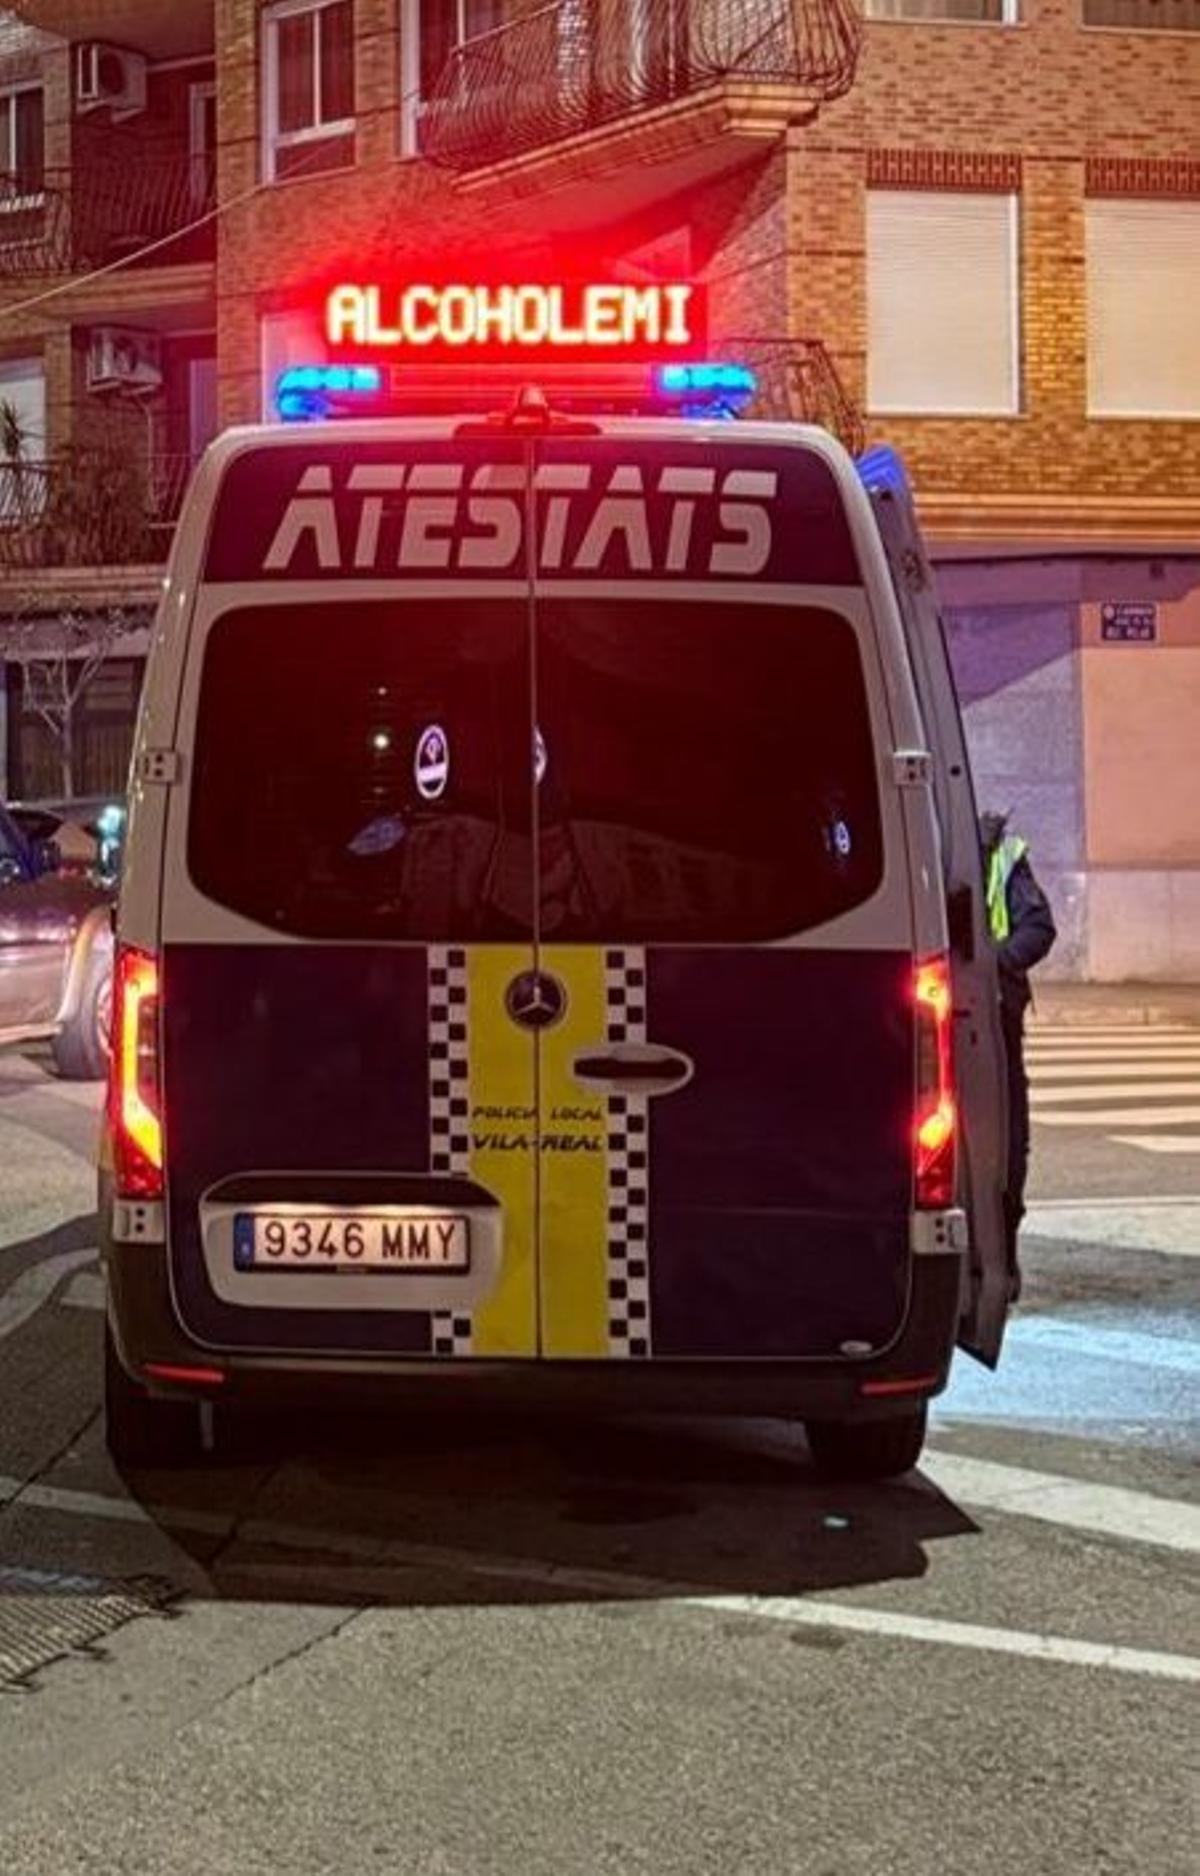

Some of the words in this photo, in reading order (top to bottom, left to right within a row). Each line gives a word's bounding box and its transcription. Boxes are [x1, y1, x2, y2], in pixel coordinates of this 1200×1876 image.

[326, 284, 693, 344] ALCOHOLEMI
[263, 464, 778, 575] ATESTATS
[472, 1106, 538, 1120] POLICIA
[551, 1106, 602, 1120] LOCAL
[264, 1220, 366, 1259] 9346
[381, 1222, 456, 1260] MMY
